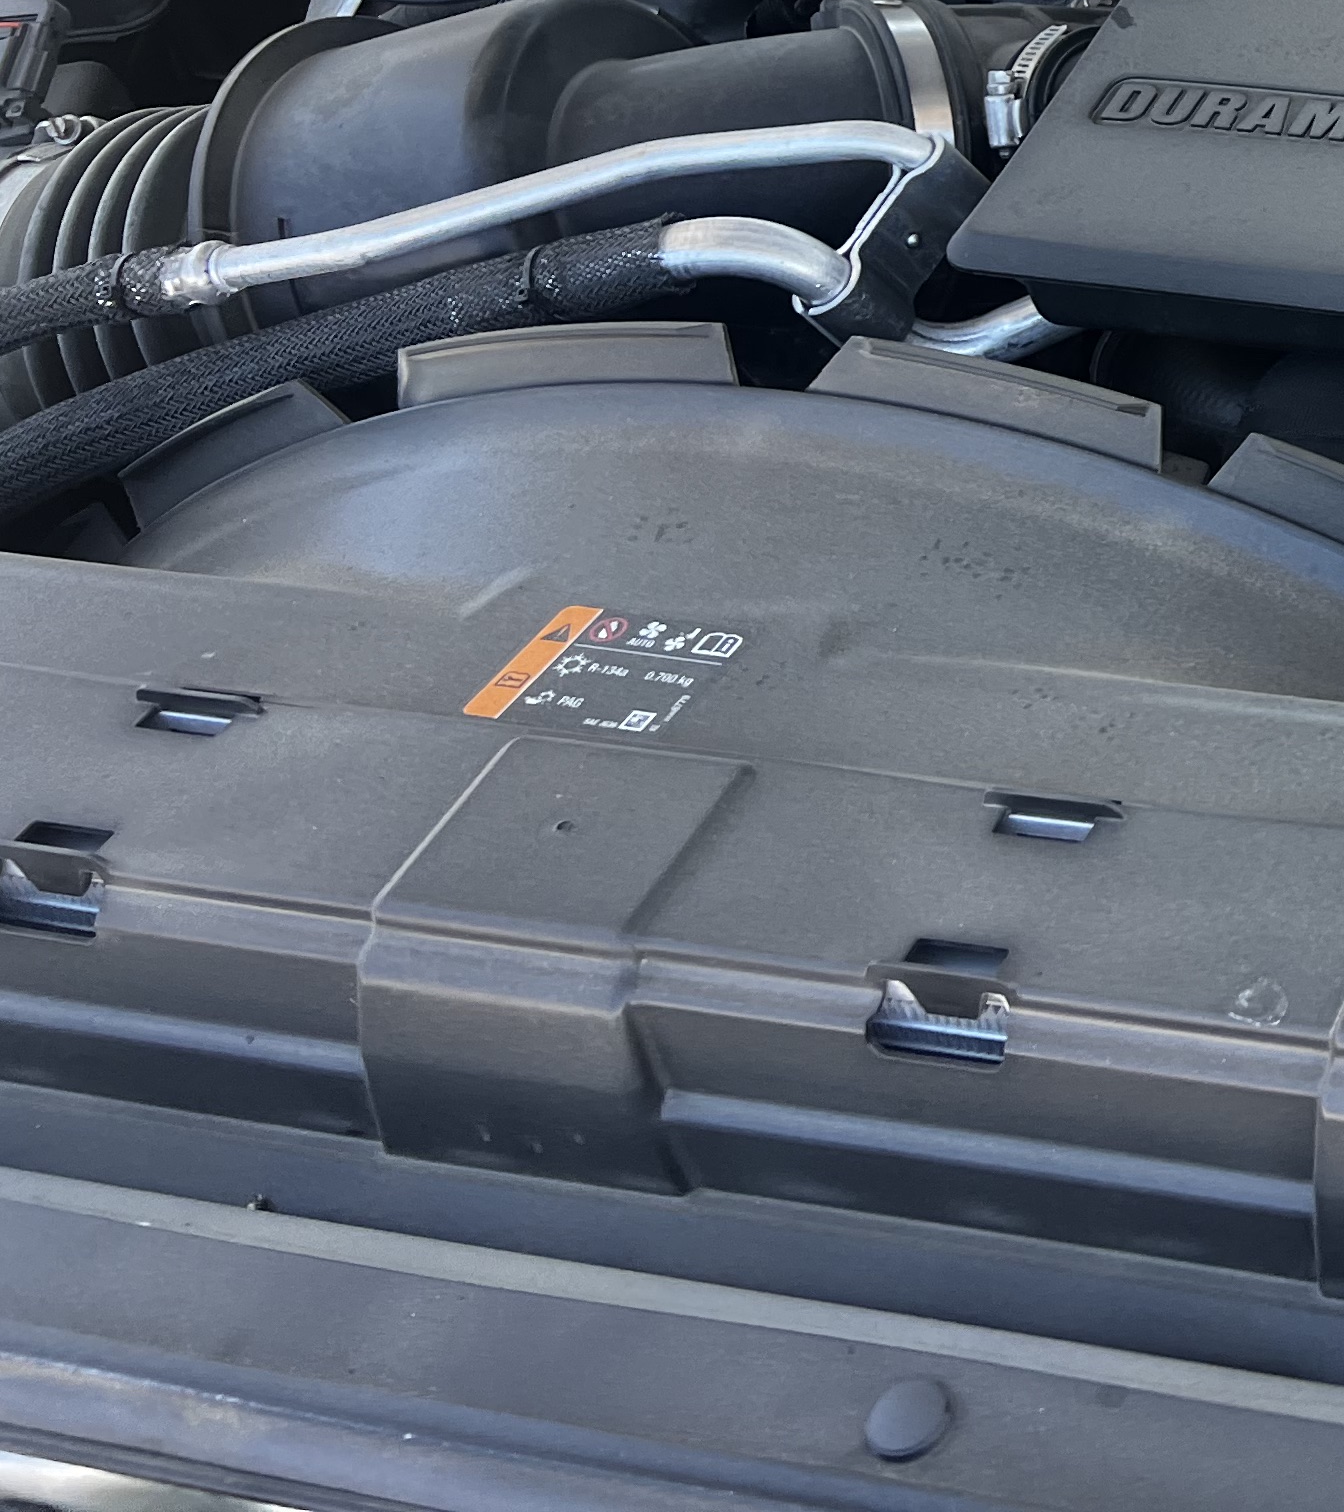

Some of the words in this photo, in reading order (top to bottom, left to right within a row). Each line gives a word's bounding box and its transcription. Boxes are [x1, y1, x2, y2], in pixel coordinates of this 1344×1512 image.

[625, 637, 656, 648] AUTO
[587, 662, 630, 677] R-134a
[643, 670, 678, 684] 0.700
[676, 675, 695, 688] kg
[557, 695, 585, 708] PAG
